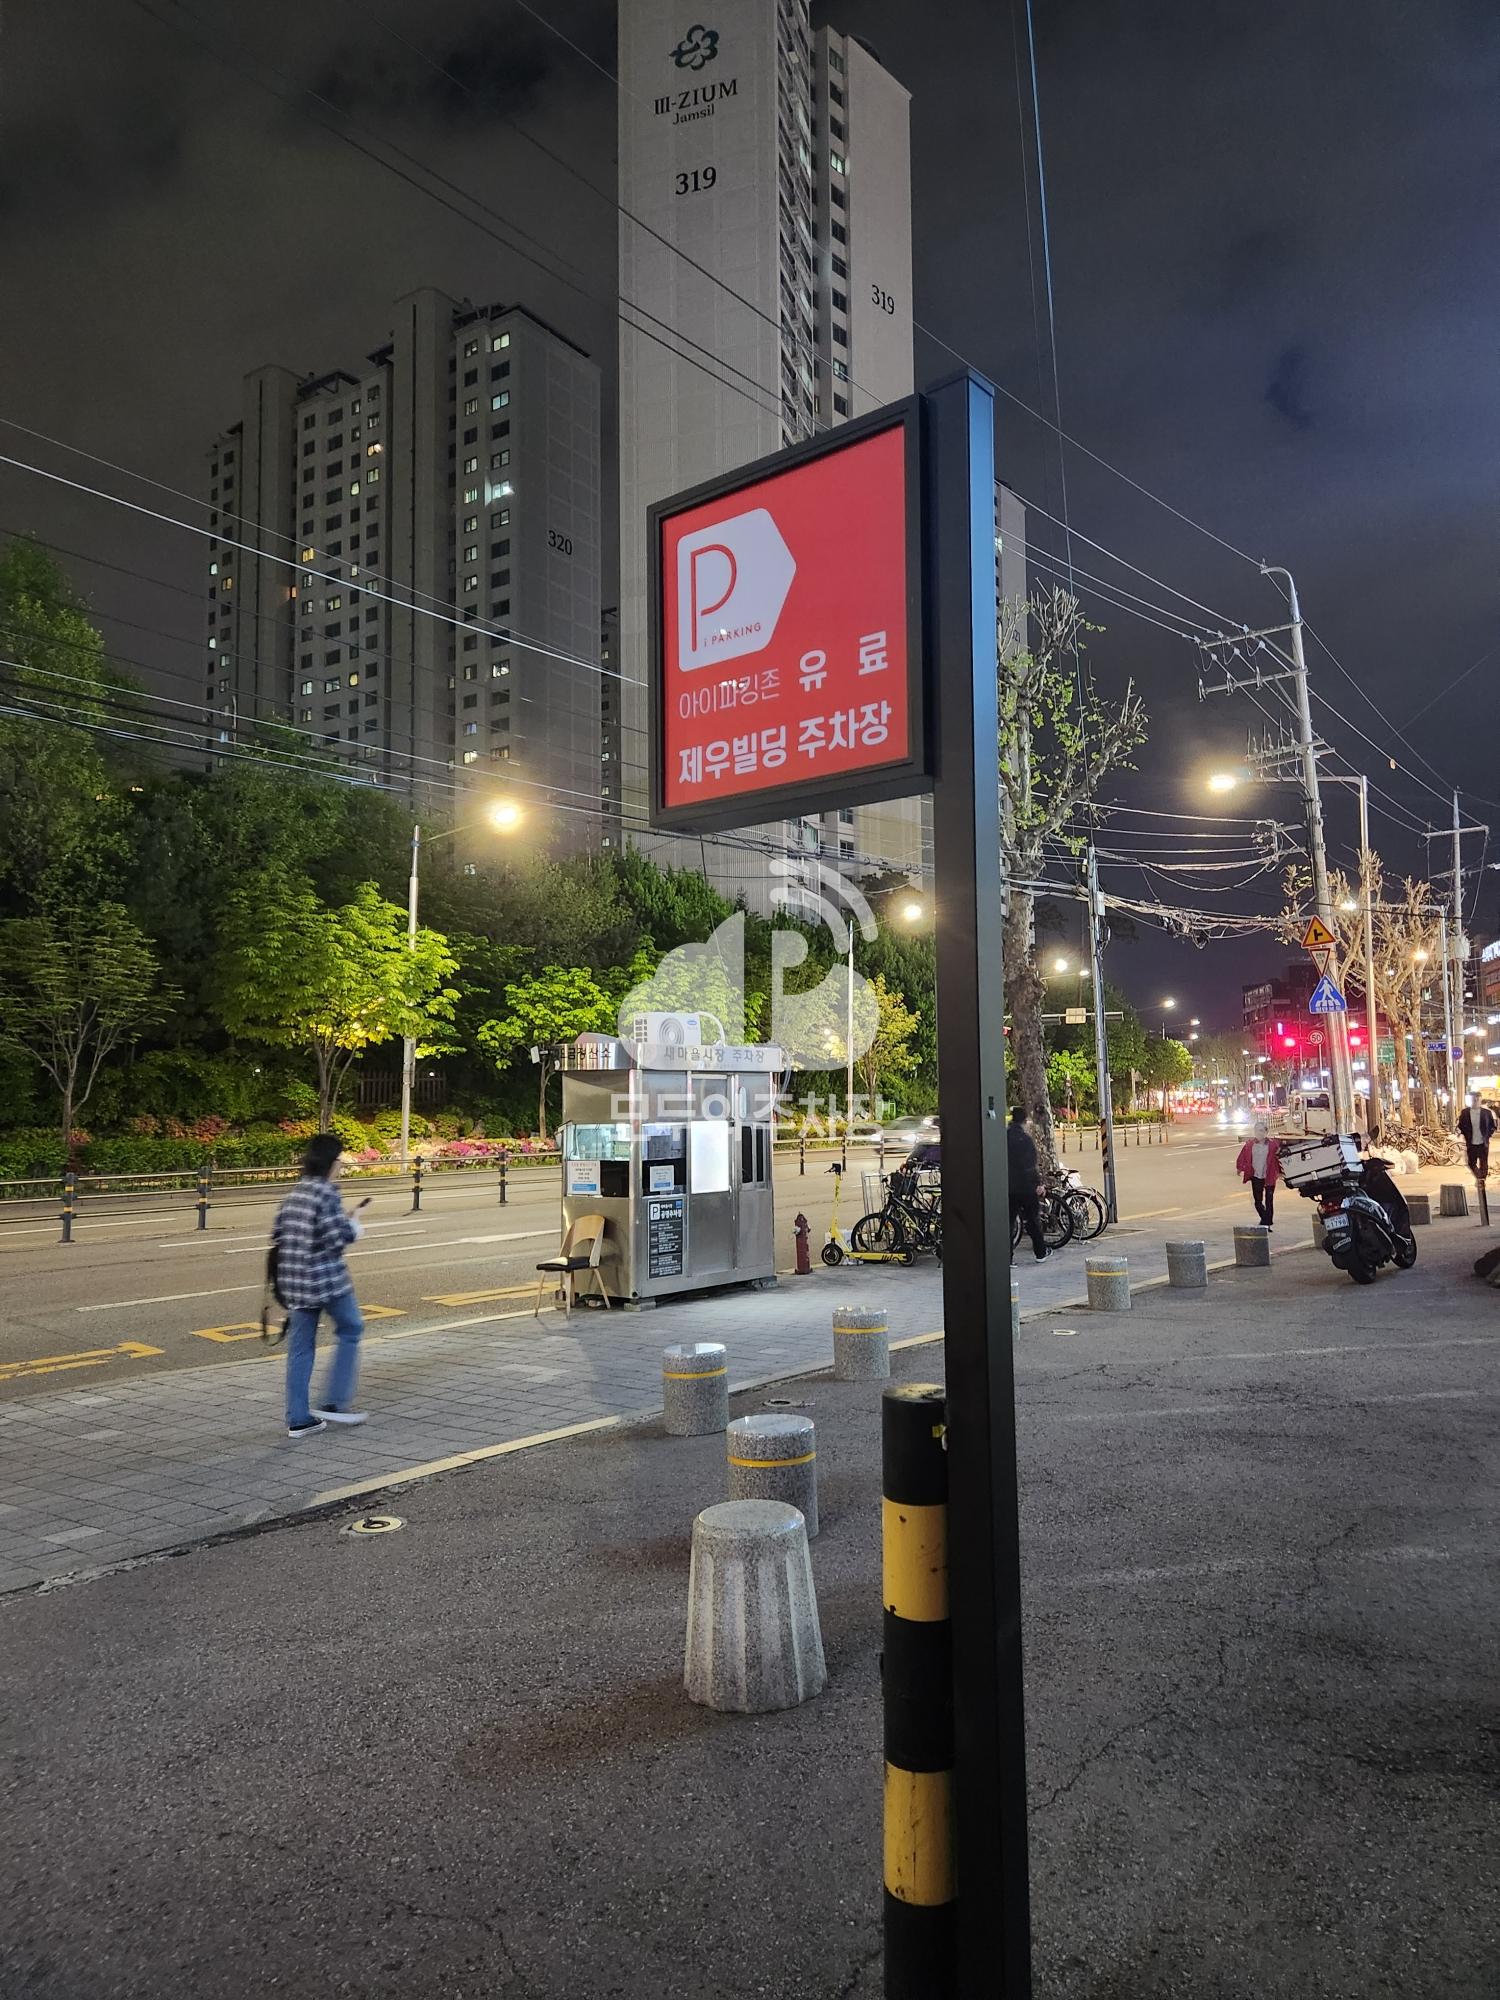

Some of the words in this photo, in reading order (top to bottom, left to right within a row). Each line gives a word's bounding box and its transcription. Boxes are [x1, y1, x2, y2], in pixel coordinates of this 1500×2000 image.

[672, 104, 715, 125] Jamsil
[675, 166, 717, 195] 319
[871, 284, 895, 315] 319
[548, 530, 572, 556] 320
[711, 621, 763, 646] PARKING
[679, 668, 781, 719] 아이파킹존
[679, 725, 787, 784] 제우빌딩
[797, 700, 892, 759] 주차장
[1312, 1033, 1322, 1042] 50
